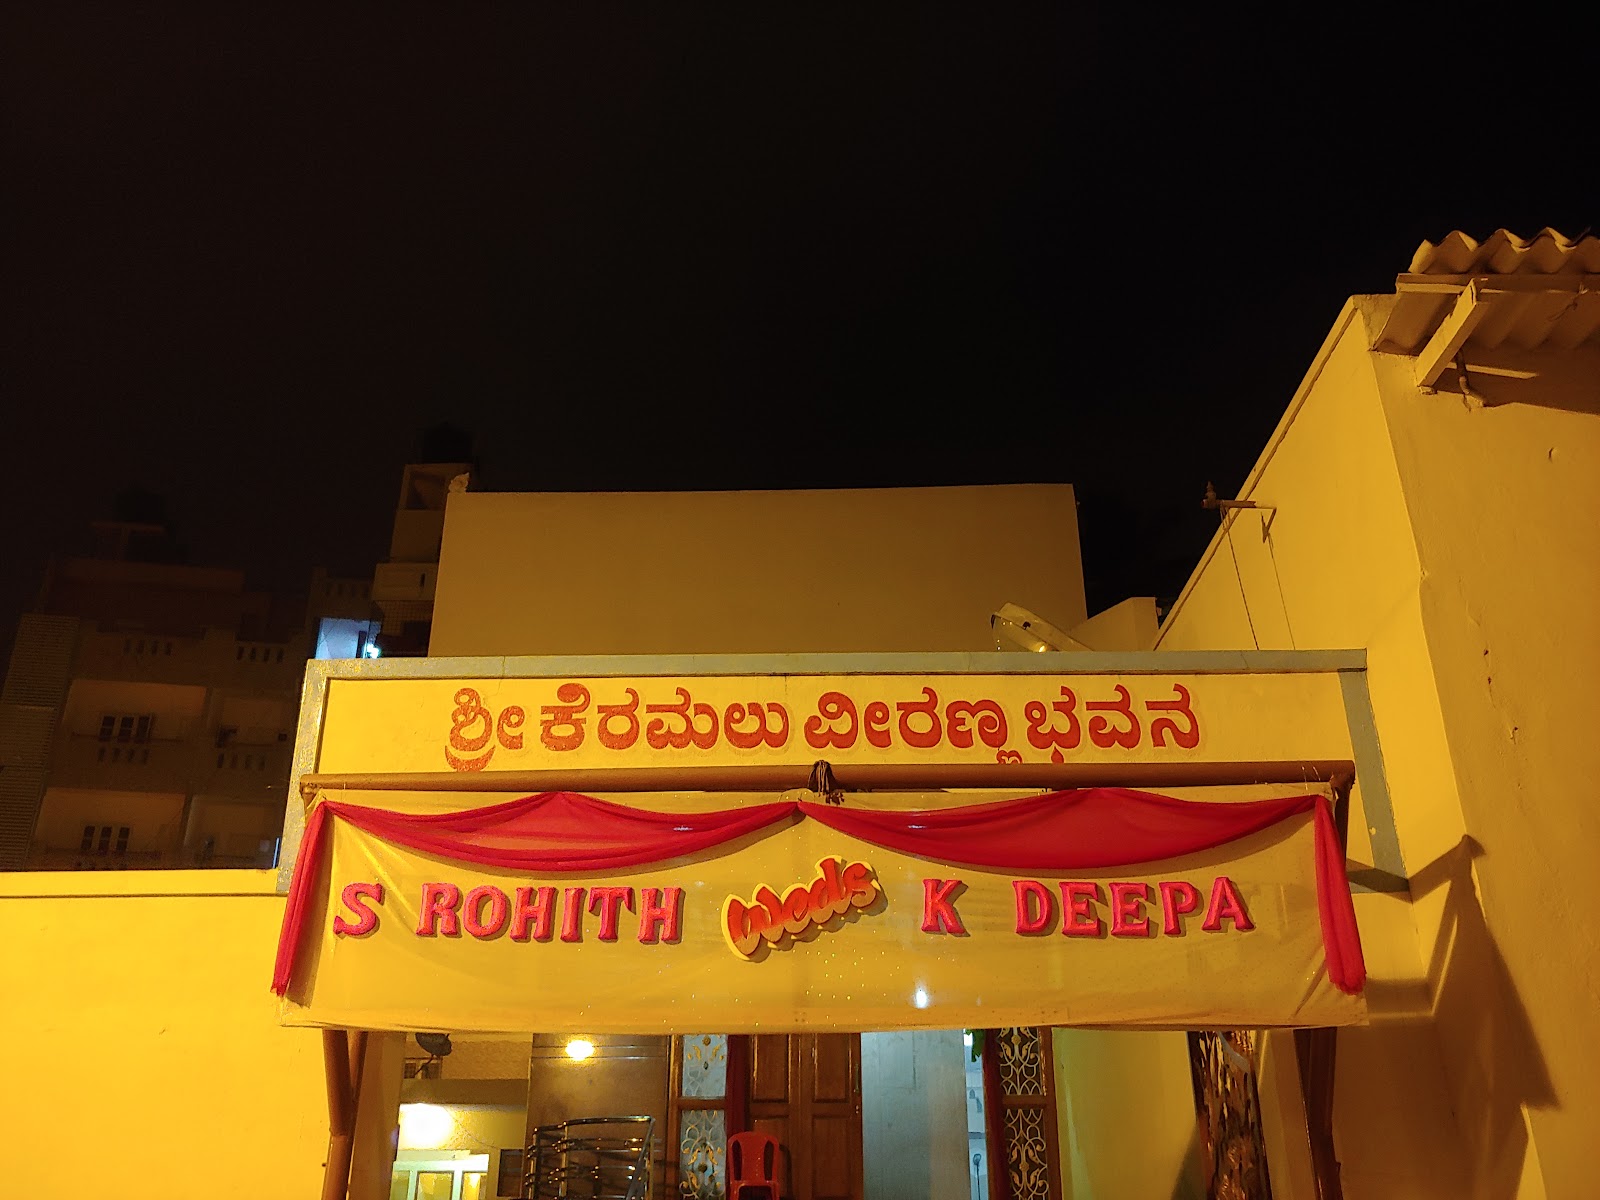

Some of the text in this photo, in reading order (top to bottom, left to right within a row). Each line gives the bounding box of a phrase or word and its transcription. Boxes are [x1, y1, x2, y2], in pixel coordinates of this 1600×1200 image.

[445, 683, 1200, 772] ಶ್ರೀ ಕೆರಮಲು ವೀರಣ್ಣ ಭವನ
[334, 883, 383, 937] S
[416, 883, 682, 944] ROHITH
[921, 879, 965, 935] K
[1012, 876, 1249, 937] DEEPA
